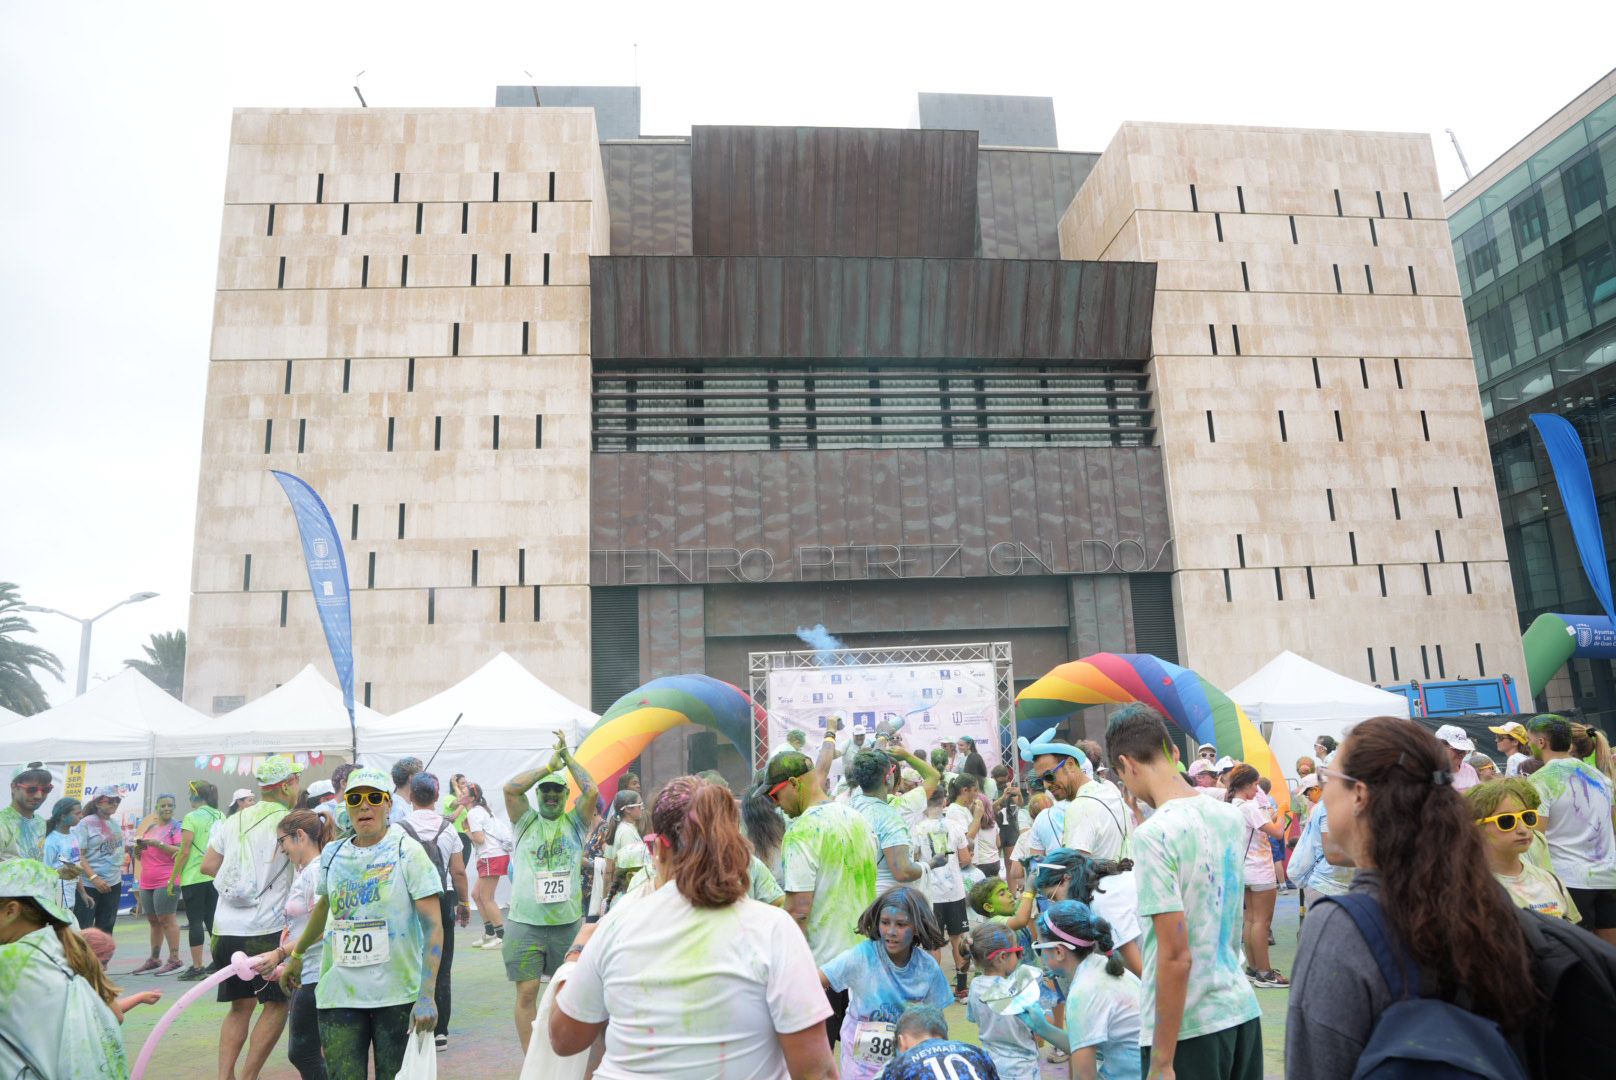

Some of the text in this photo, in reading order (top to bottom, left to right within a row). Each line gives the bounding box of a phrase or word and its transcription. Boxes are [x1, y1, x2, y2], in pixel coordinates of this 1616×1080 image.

[70, 765, 81, 775] 14
[543, 880, 564, 894] 225
[343, 934, 373, 954] 220
[911, 1045, 957, 1063] NEYMAR
[923, 1053, 982, 1080] 10
